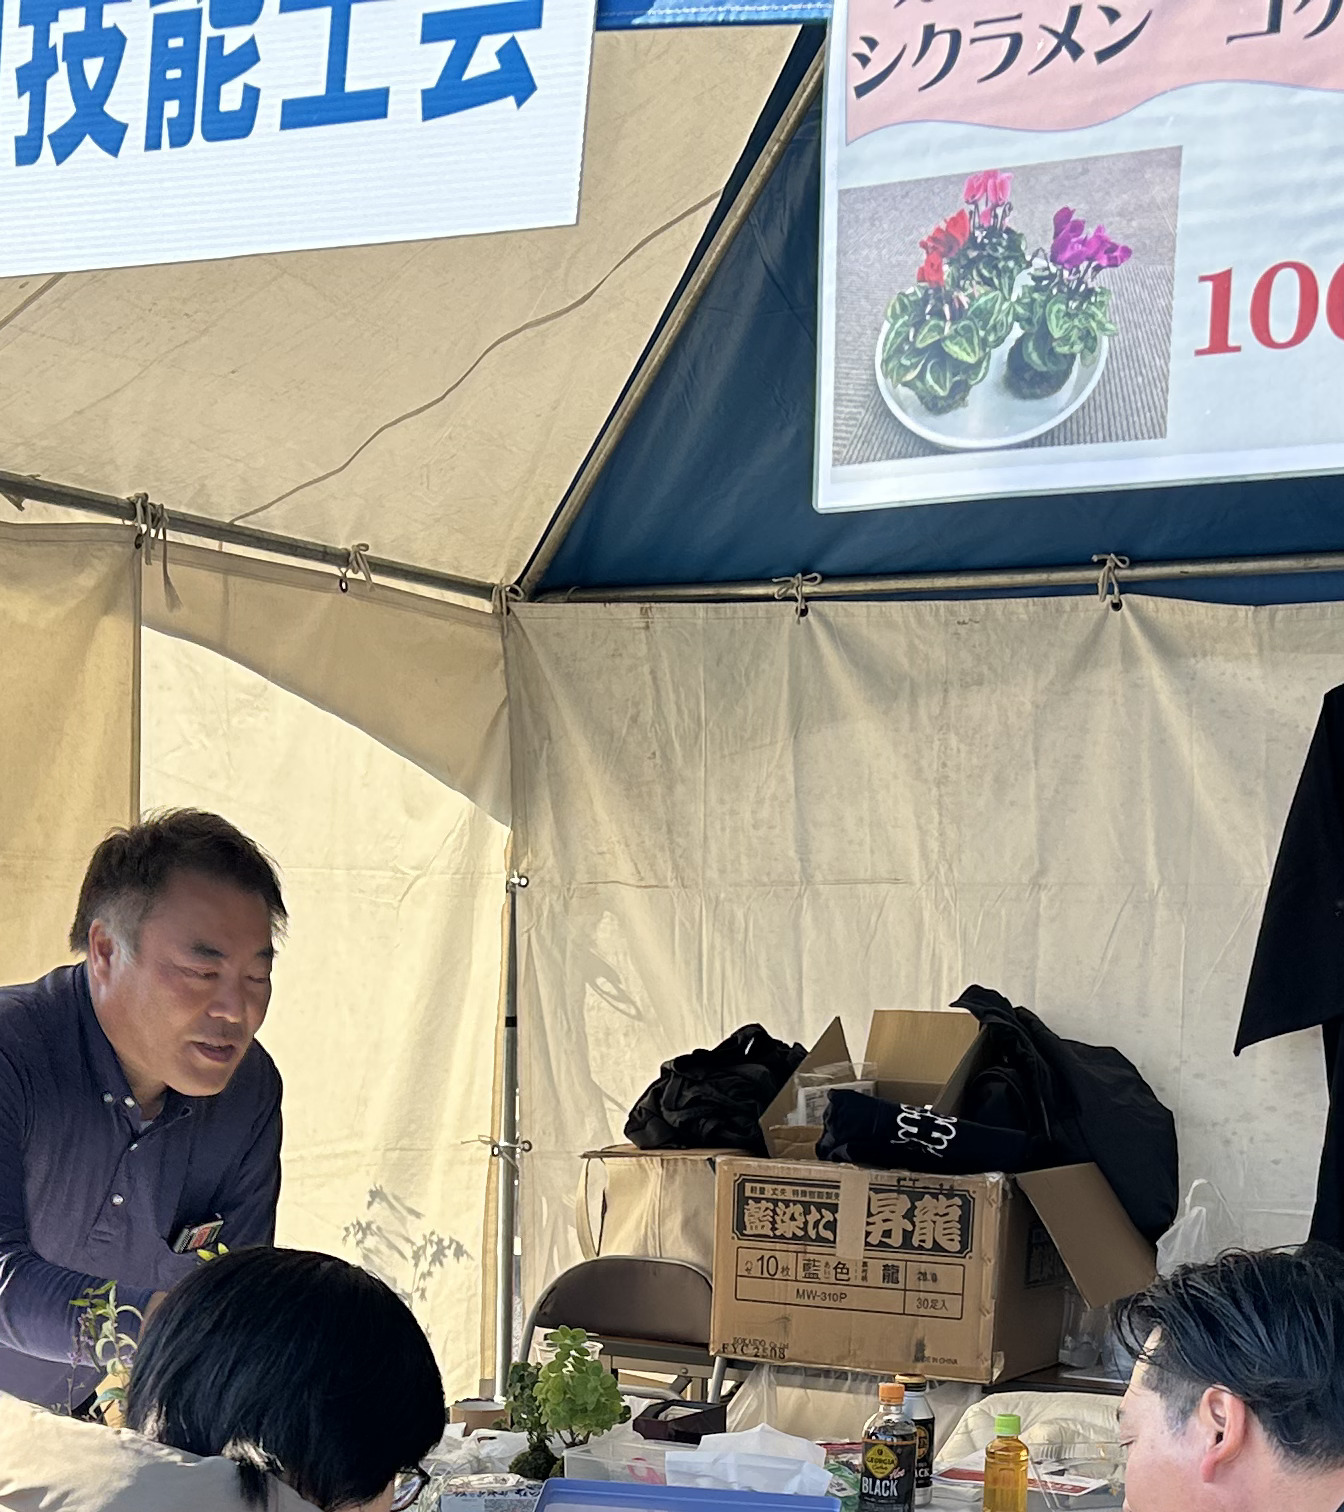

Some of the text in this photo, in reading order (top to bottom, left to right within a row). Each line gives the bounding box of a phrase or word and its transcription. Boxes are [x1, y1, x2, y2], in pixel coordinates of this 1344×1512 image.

[850, 3, 1155, 99] シクラメン
[743, 1190, 962, 1253] 藍染た 昇龍
[796, 1287, 848, 1304] MW-310P
[861, 1476, 898, 1497] BLACK
